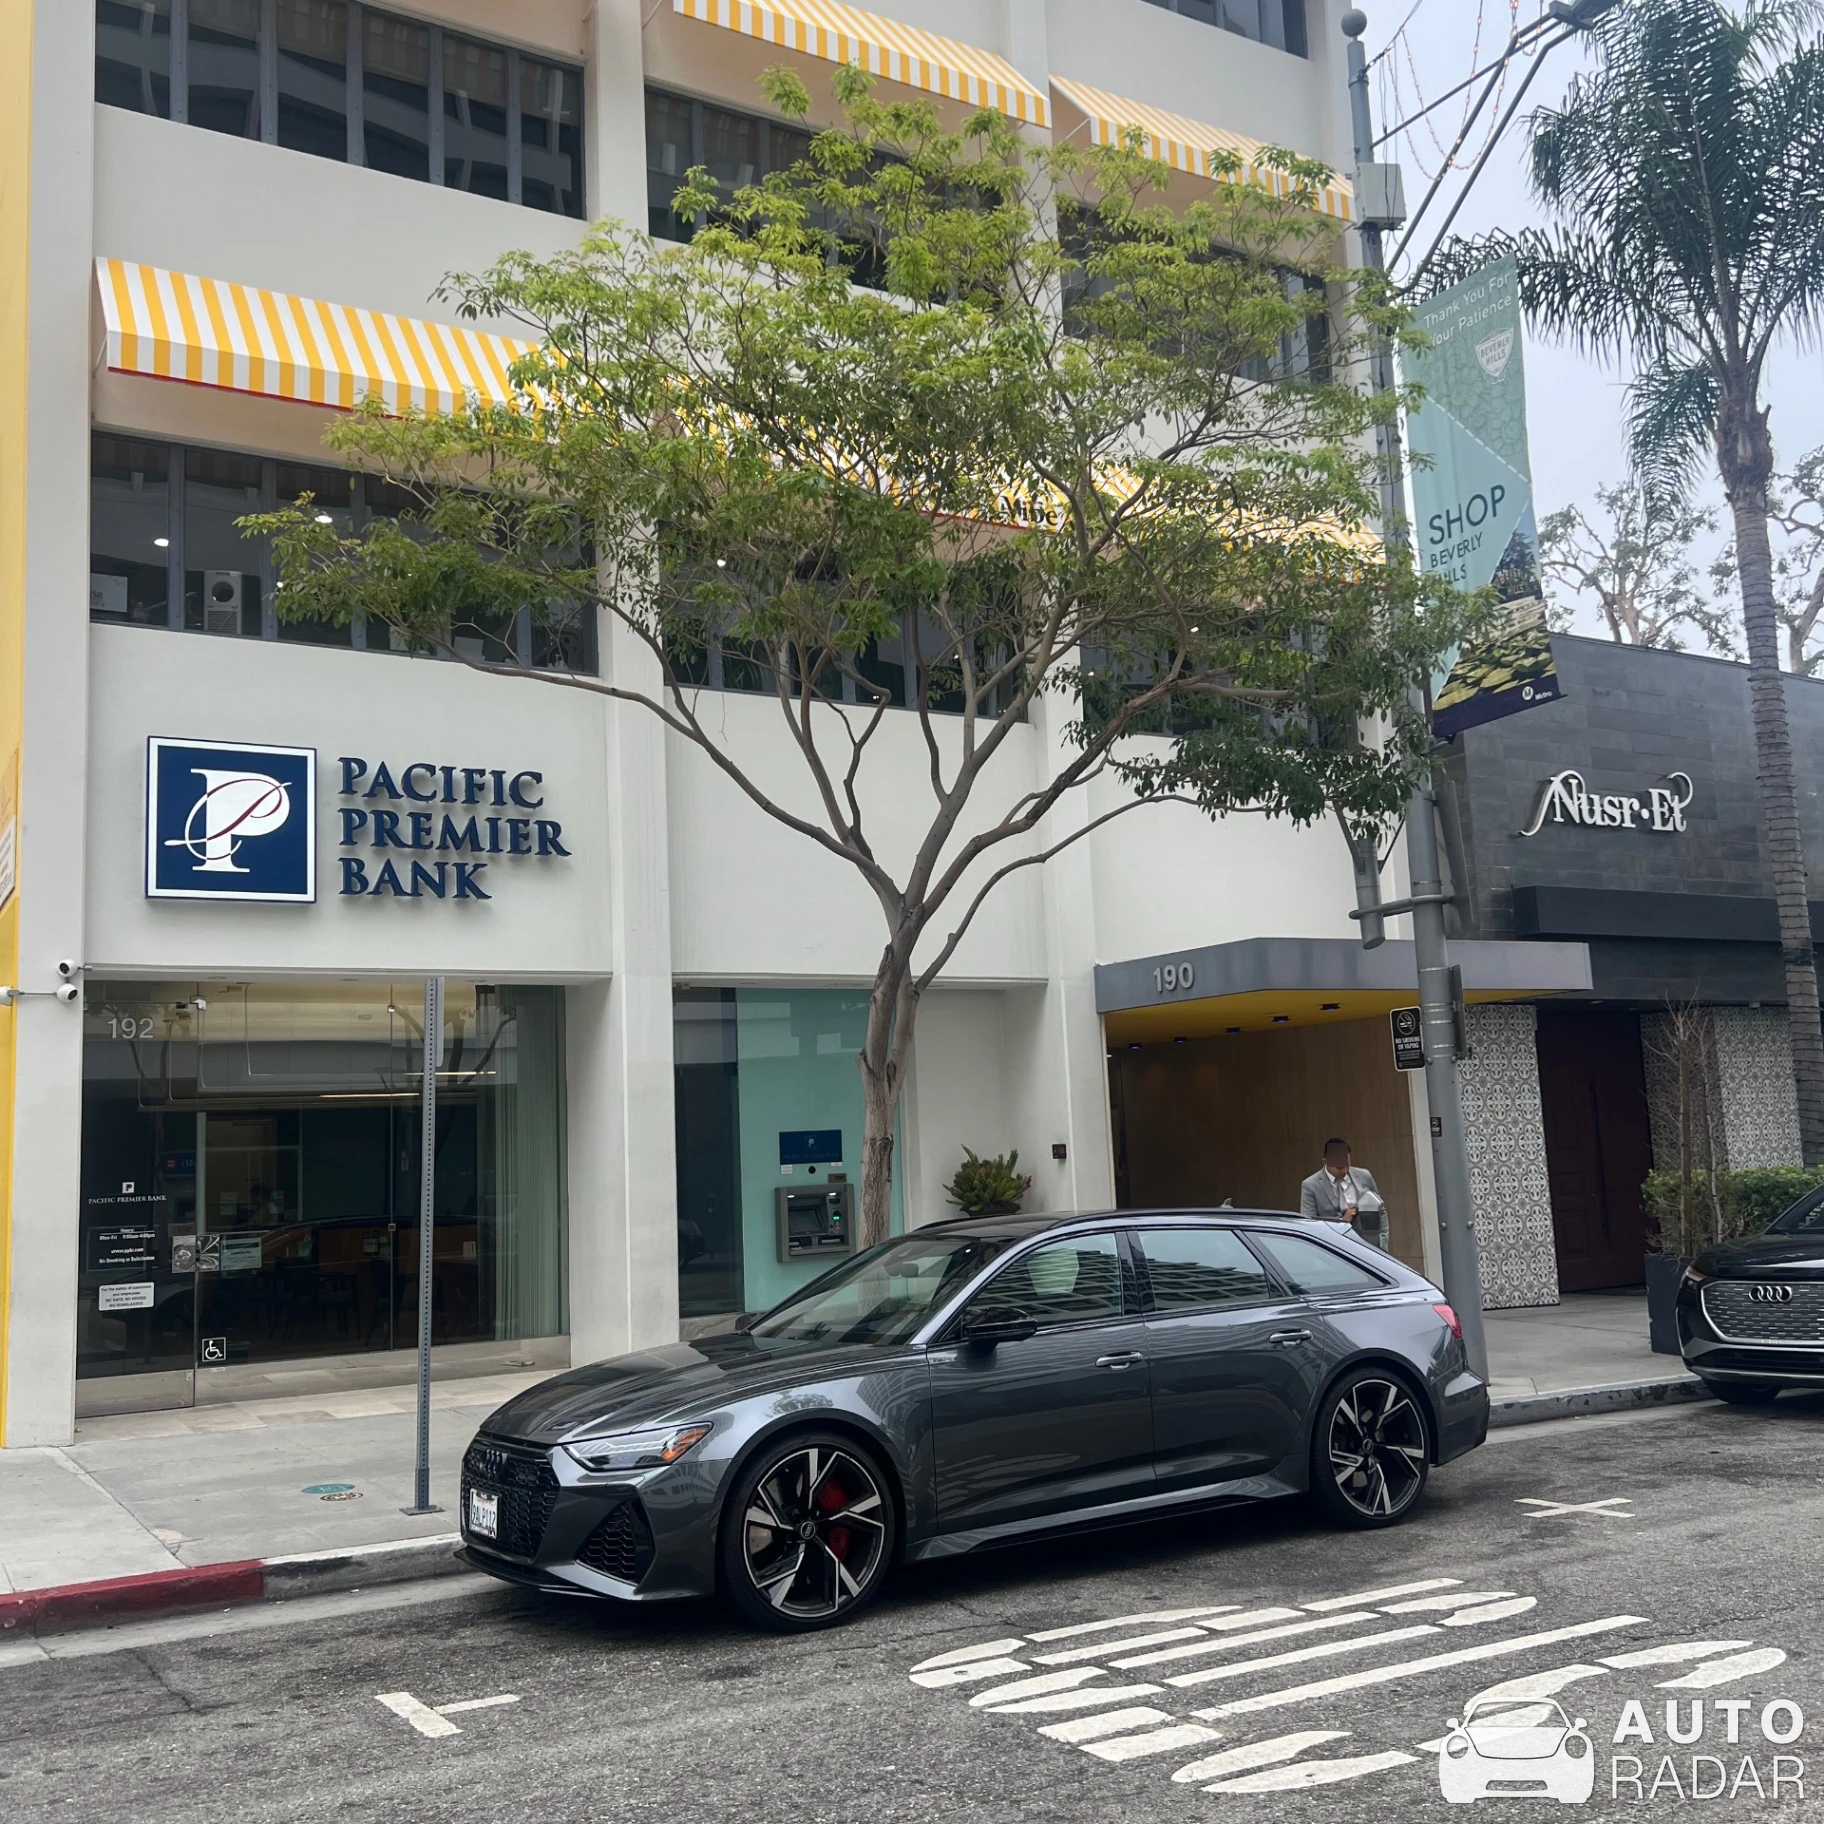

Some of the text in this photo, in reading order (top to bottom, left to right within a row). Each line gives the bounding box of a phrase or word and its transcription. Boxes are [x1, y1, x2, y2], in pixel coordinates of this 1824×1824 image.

[1423, 272, 1511, 329] Thank You For
[1458, 294, 1513, 332] Patience
[1480, 335, 1510, 358] BEVERLY
[1486, 348, 1506, 367] HILLS
[1429, 484, 1506, 546] SHOP
[1430, 531, 1483, 568] BEVERLY
[337, 756, 544, 810] PACIFIC
[337, 807, 572, 857] PREMIER
[337, 857, 493, 900] BANK
[1153, 962, 1195, 993] 190
[106, 1017, 154, 1039] 192
[88, 1197, 116, 1205] PACIFIC
